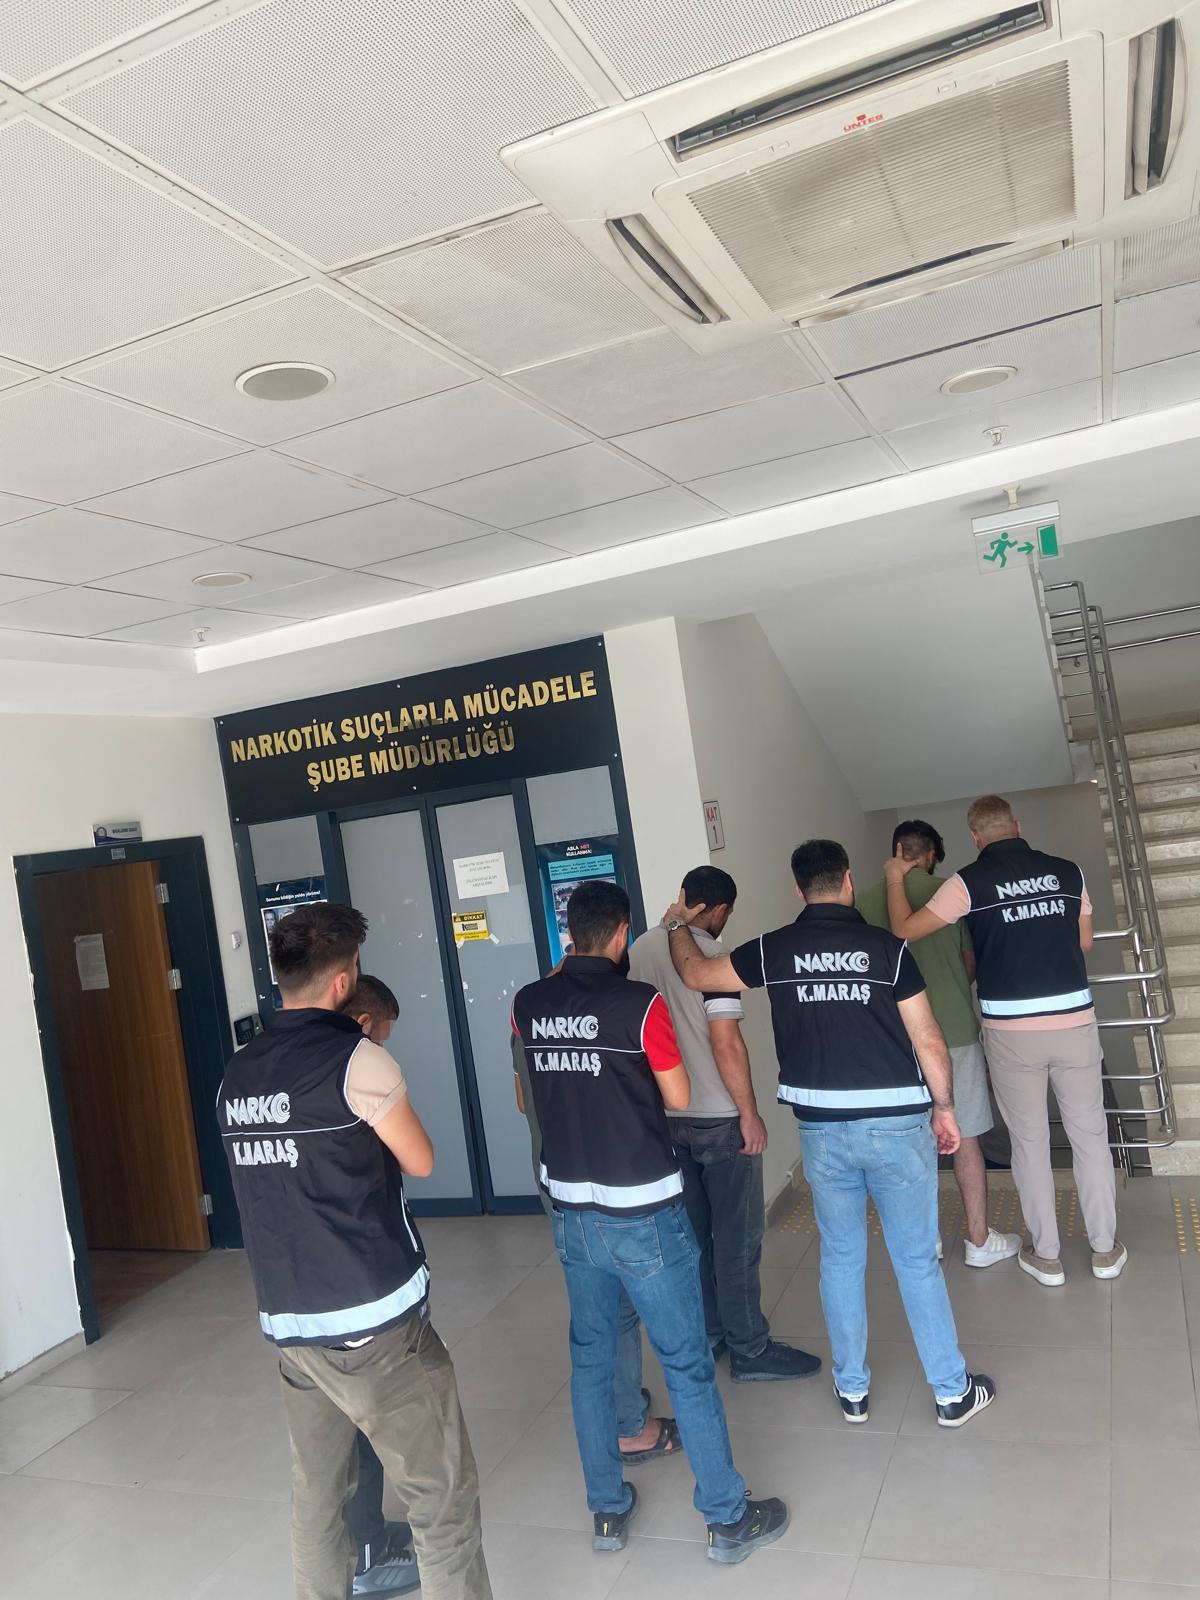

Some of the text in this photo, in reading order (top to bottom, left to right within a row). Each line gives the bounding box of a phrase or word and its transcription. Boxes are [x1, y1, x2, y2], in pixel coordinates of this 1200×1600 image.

[231, 670, 598, 762] NARKOTİK SUÇLARLA MÜCADELE
[307, 720, 516, 792] ŞUBE MÜDÜRLÜĞÜ
[995, 874, 1060, 900] NARKO
[1001, 899, 1066, 923] K.MARAŞ
[793, 951, 870, 974] NARKO
[796, 983, 871, 1005] K.MARAŞ
[531, 1015, 599, 1040] NARKO
[533, 1051, 602, 1077] K.MARAŞ
[225, 1092, 291, 1126] NARKO
[232, 1138, 299, 1168] K.MARAŞ
